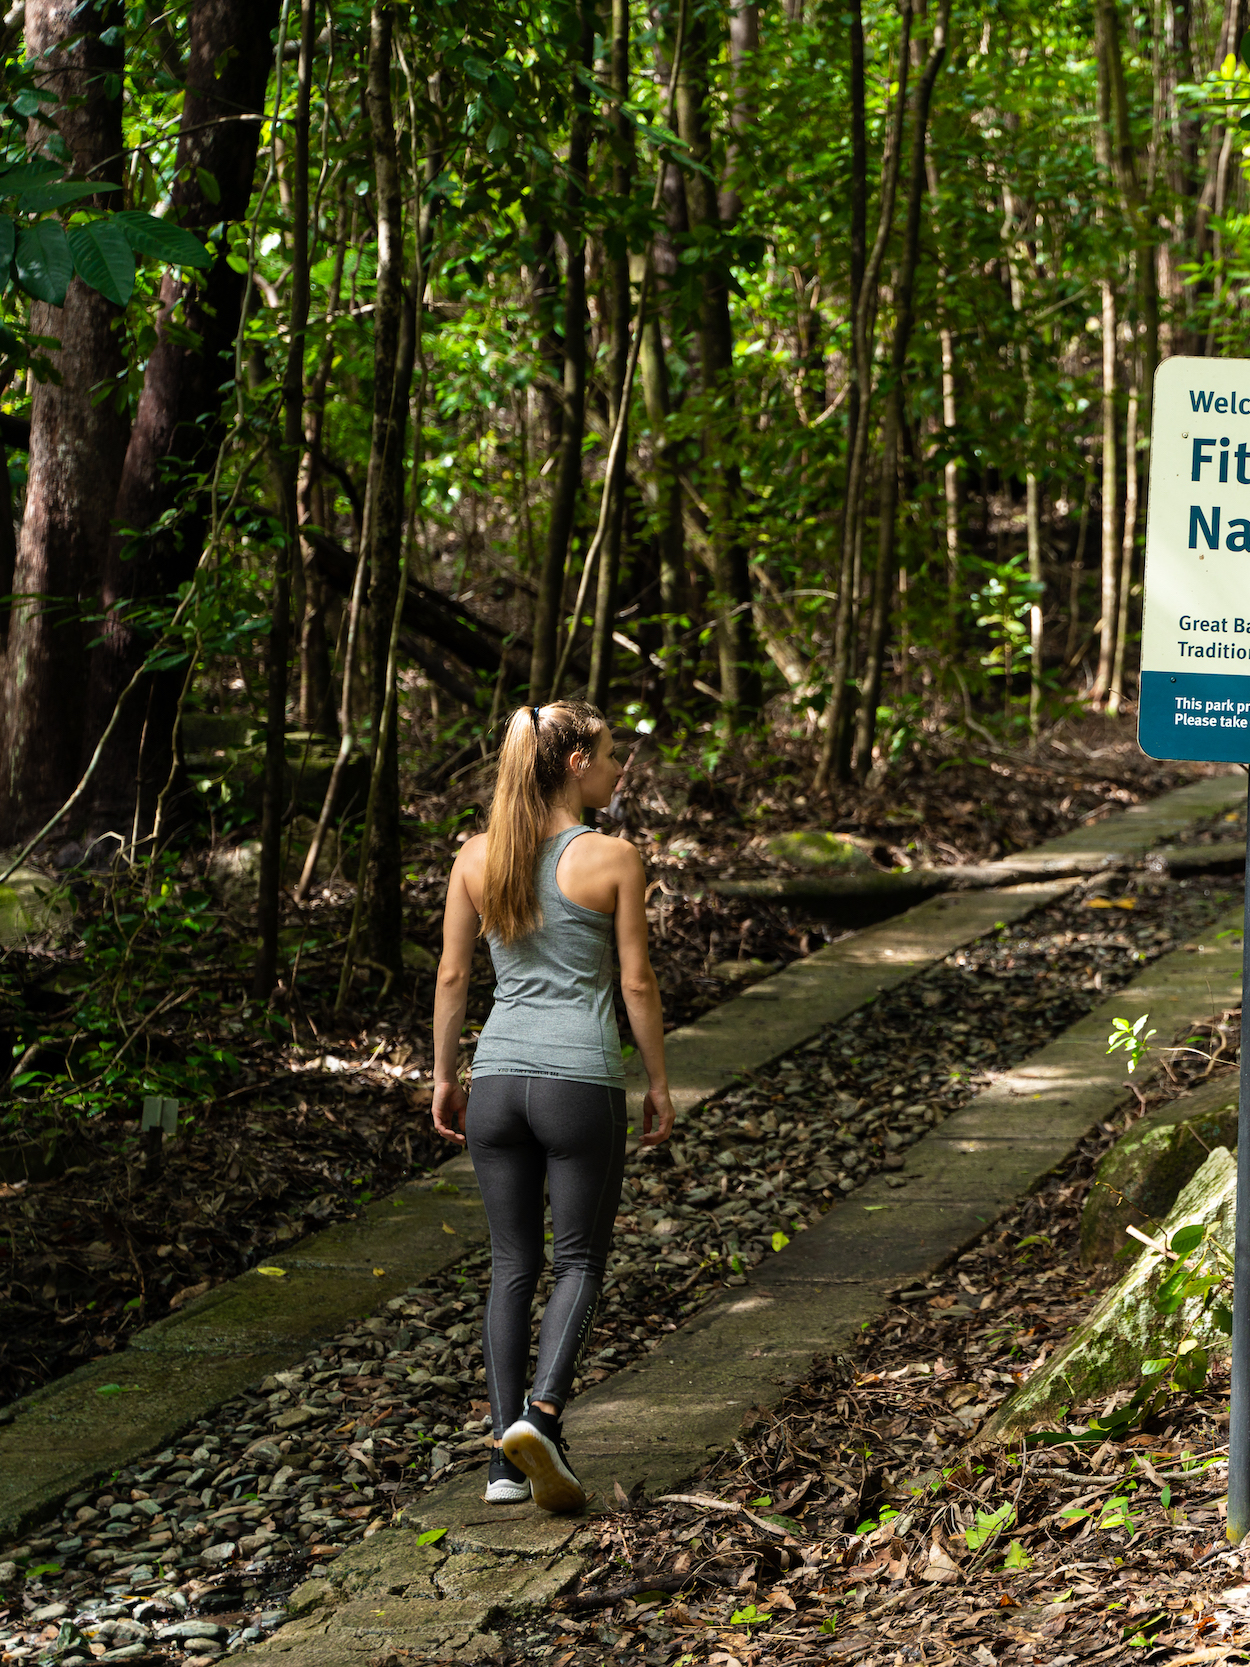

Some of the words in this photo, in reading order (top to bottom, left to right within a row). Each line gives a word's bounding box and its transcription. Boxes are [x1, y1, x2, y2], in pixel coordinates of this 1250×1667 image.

[1179, 615, 1228, 633] Great
[1174, 696, 1203, 711] This
[1205, 698, 1235, 714] park
[1174, 712, 1218, 727] Please
[1219, 714, 1249, 729] take
